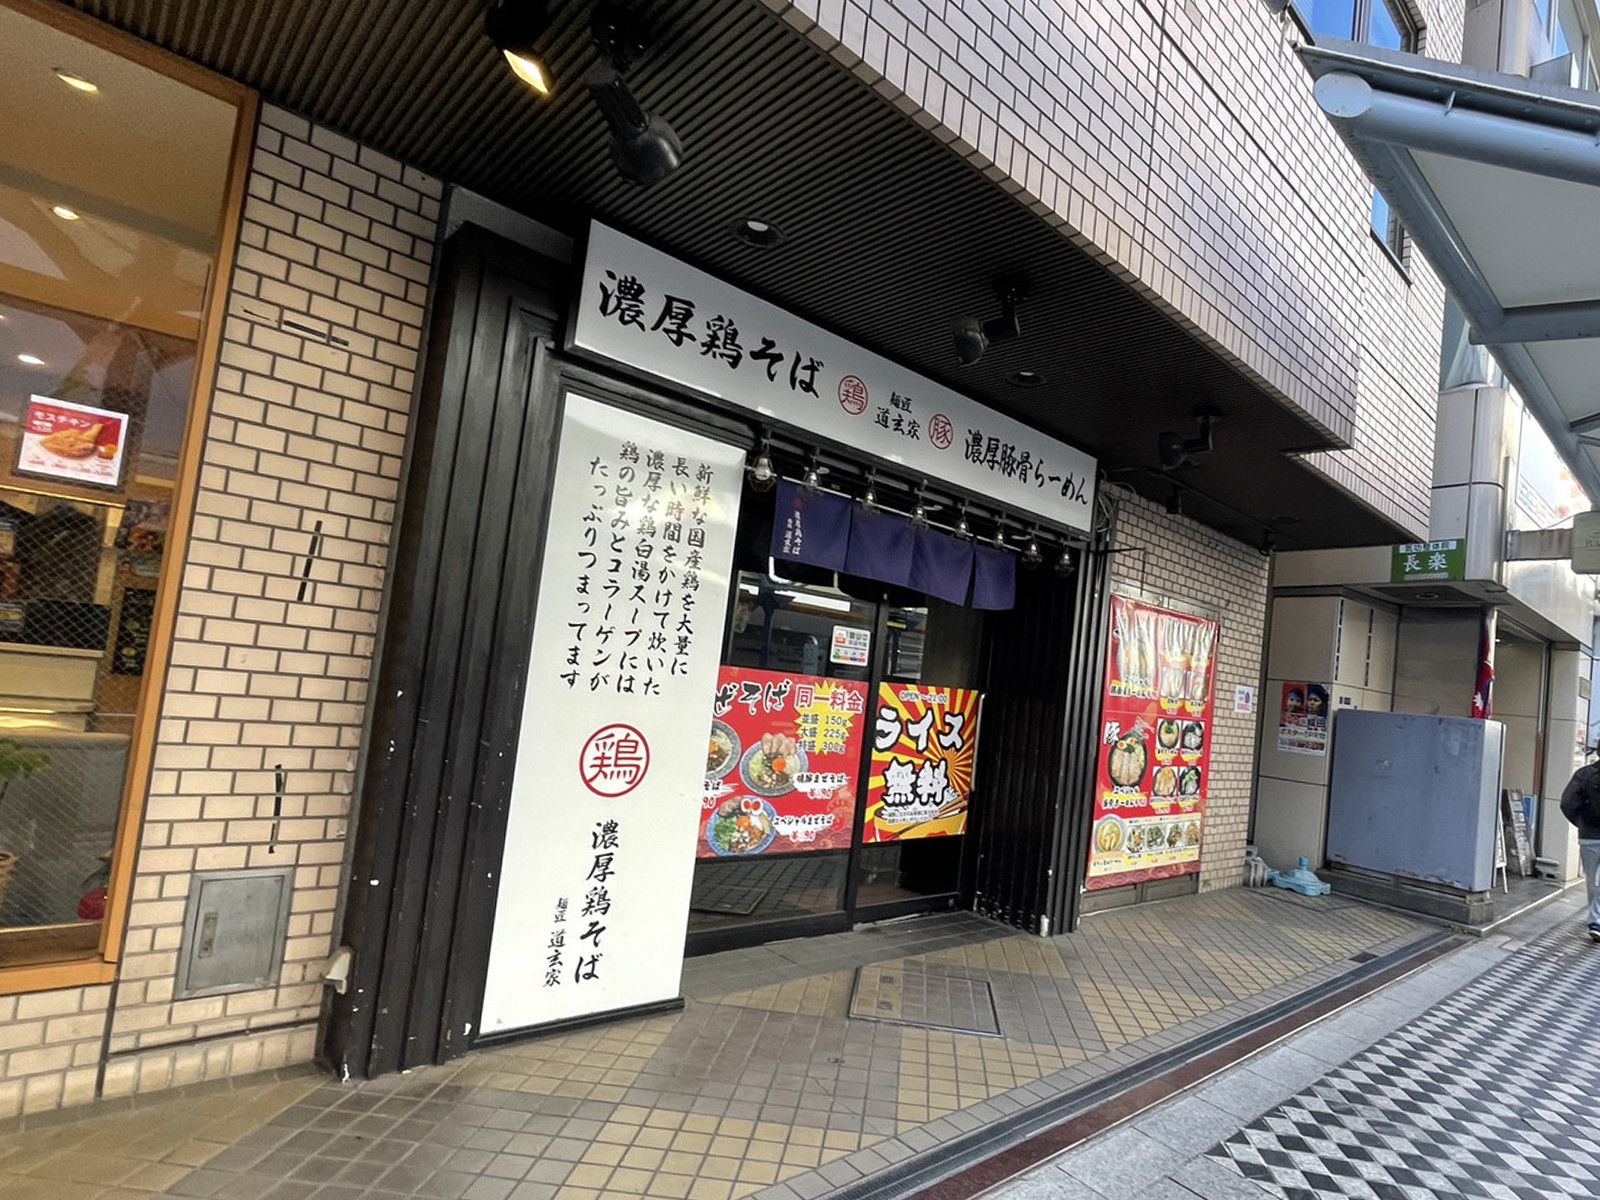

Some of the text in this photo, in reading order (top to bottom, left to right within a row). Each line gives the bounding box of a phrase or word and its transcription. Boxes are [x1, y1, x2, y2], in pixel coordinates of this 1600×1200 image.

[598, 269, 825, 399] 濃厚鶏そば
[33, 410, 91, 428] モスチキン
[840, 378, 867, 411] 鶏
[875, 406, 920, 440] 道玄家
[930, 417, 951, 446] 豚
[964, 428, 1088, 505] 濃厚豚骨らーめん
[590, 441, 640, 692] 鶏の旨みとコラーゲンが
[617, 449, 665, 694] 濃厚な鶏白湯スープには
[643, 456, 690, 696] 長い時間をかけて炊いた
[671, 463, 713, 675] 新鮮な国産鶏を大量に
[796, 685, 862, 712] 同一料金
[825, 715, 848, 728] 150g
[800, 727, 846, 740] 大盛 225g
[822, 741, 845, 753] 300g
[875, 706, 965, 752] ライス
[587, 732, 644, 785] 鶏
[882, 757, 949, 807] 無料
[575, 819, 619, 983] 濃厚鶏そば
[542, 928, 566, 987] 道玄家
